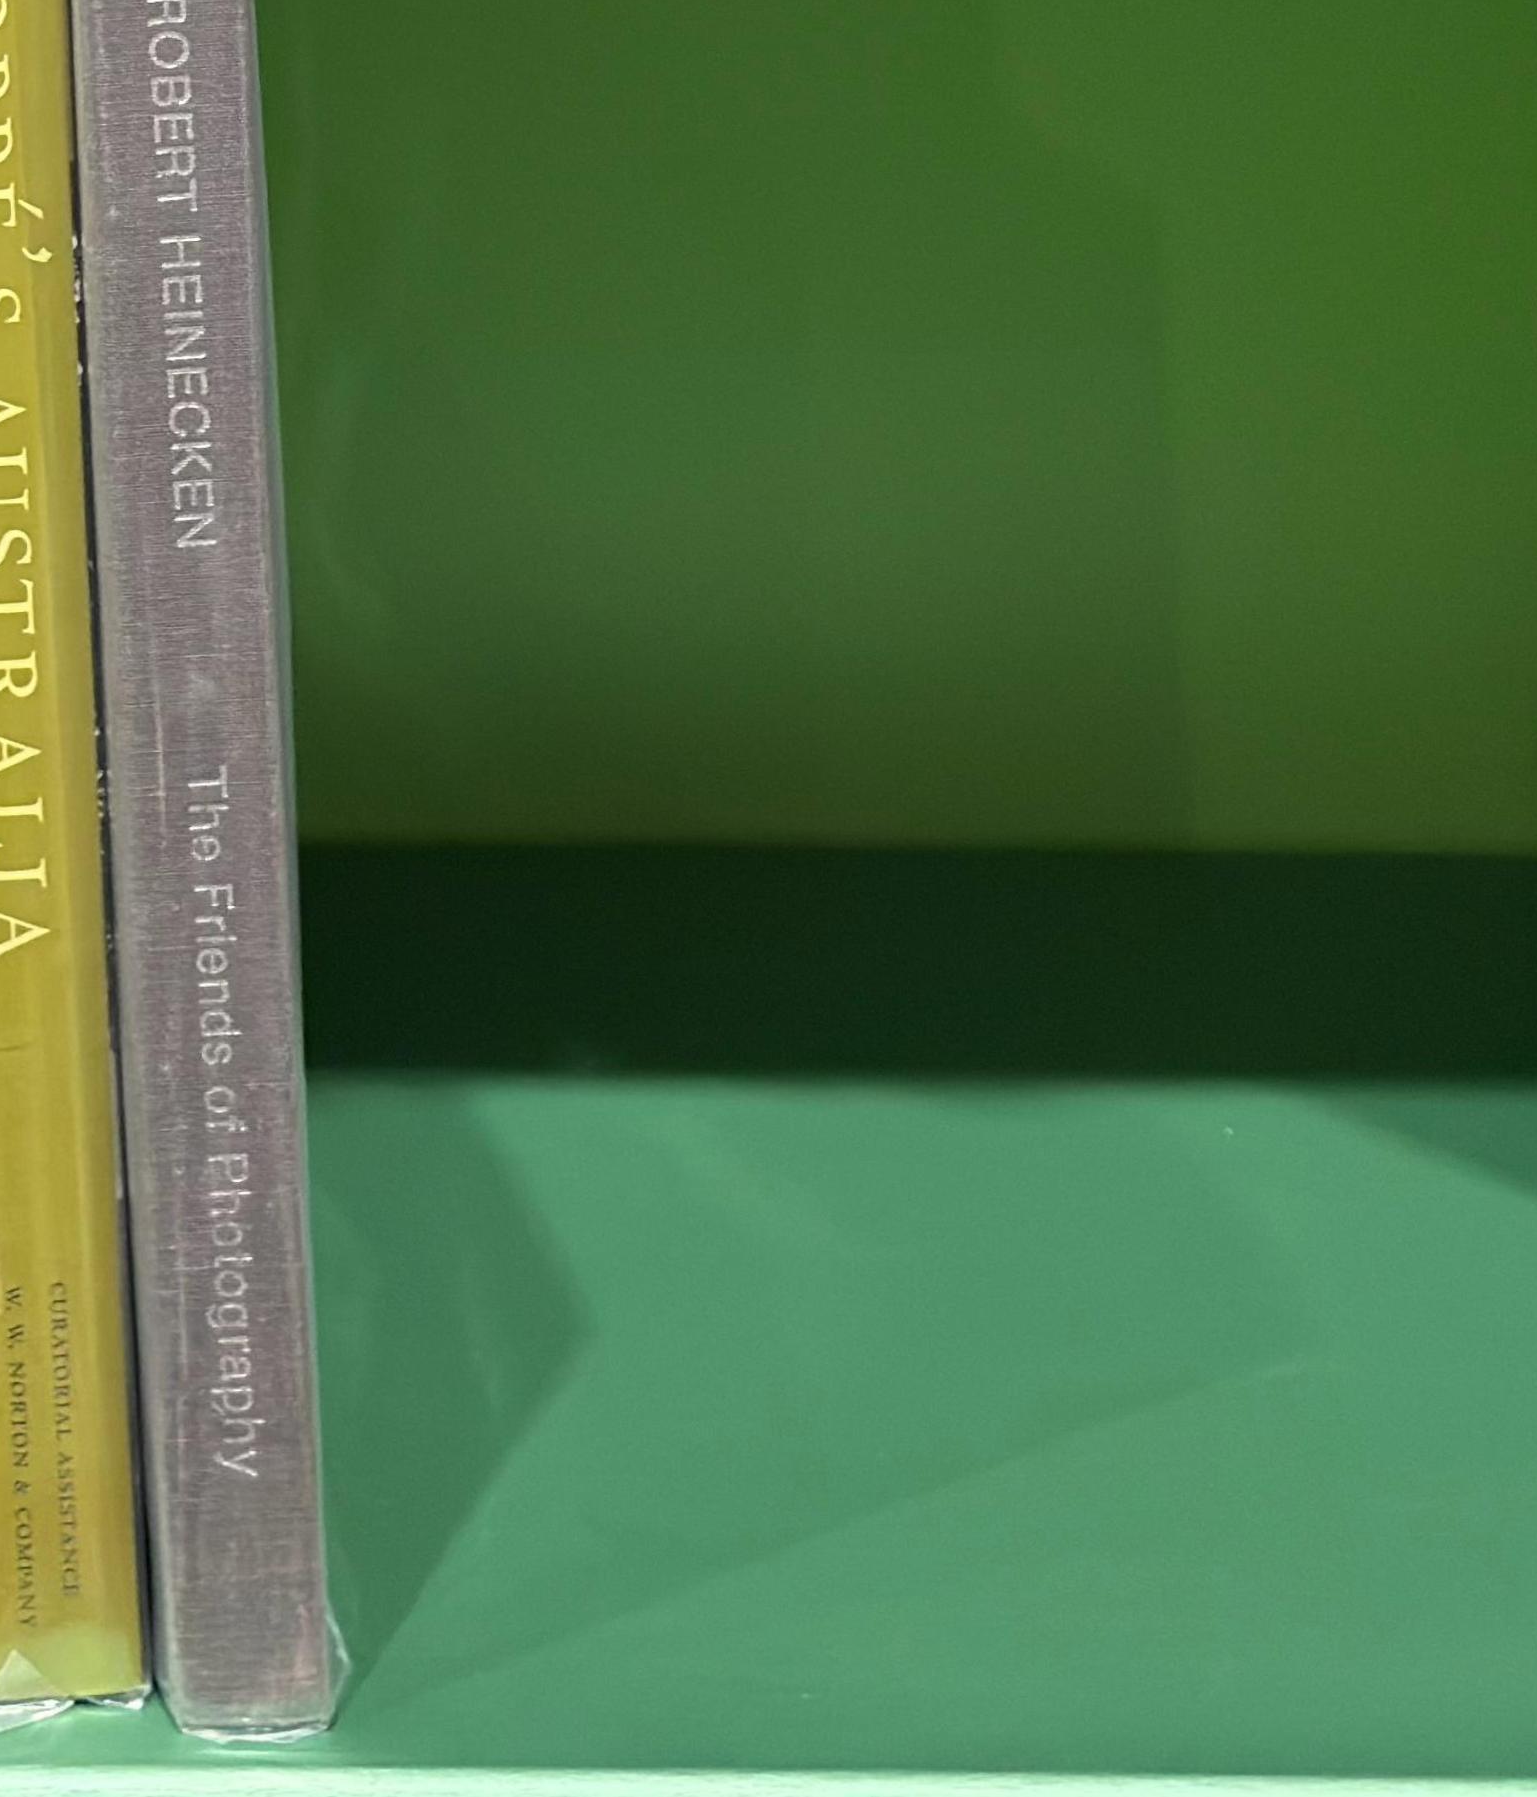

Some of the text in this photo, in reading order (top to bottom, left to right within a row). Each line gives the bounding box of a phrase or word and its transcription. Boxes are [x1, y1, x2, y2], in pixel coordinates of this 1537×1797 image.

[159, 238, 217, 551] HEINECKEN
[186, 764, 263, 1480] The Friends of Photography
[5, 1287, 36, 1627] W. W. NORTON & COMPANY
[49, 1282, 80, 1597] CURATORIAL ASSISTANCE
